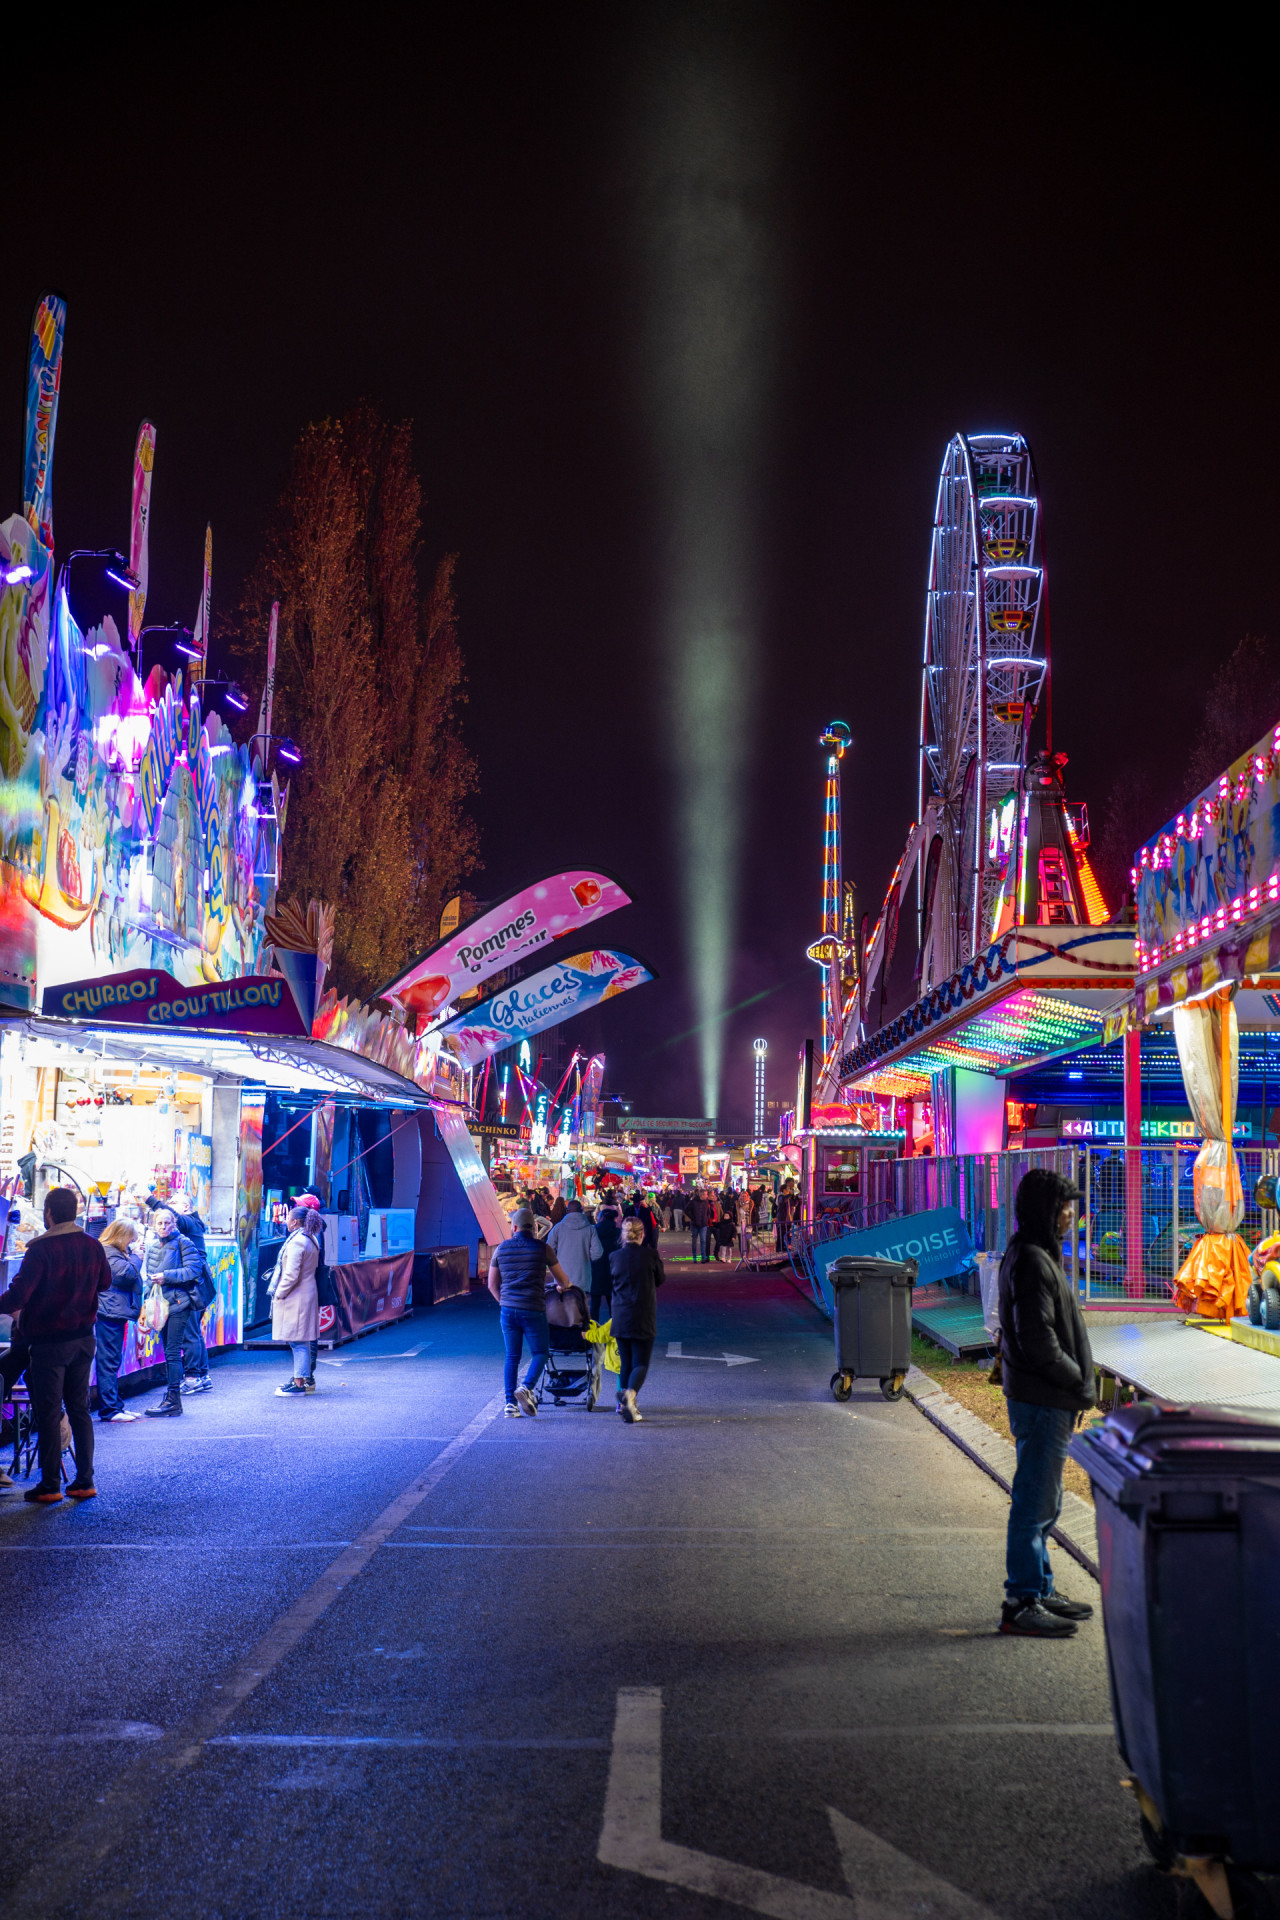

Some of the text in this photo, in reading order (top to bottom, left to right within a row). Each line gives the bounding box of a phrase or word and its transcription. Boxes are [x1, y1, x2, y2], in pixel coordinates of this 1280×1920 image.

[457, 909, 536, 968] Pommes
[62, 977, 158, 1013] CHURROS
[148, 980, 283, 1022] CROUSTILLONS
[492, 970, 580, 1026] Glaces
[517, 996, 576, 1027] Italiennes
[466, 1124, 517, 1136] PACHINKO
[863, 1228, 958, 1261] NTOISE
